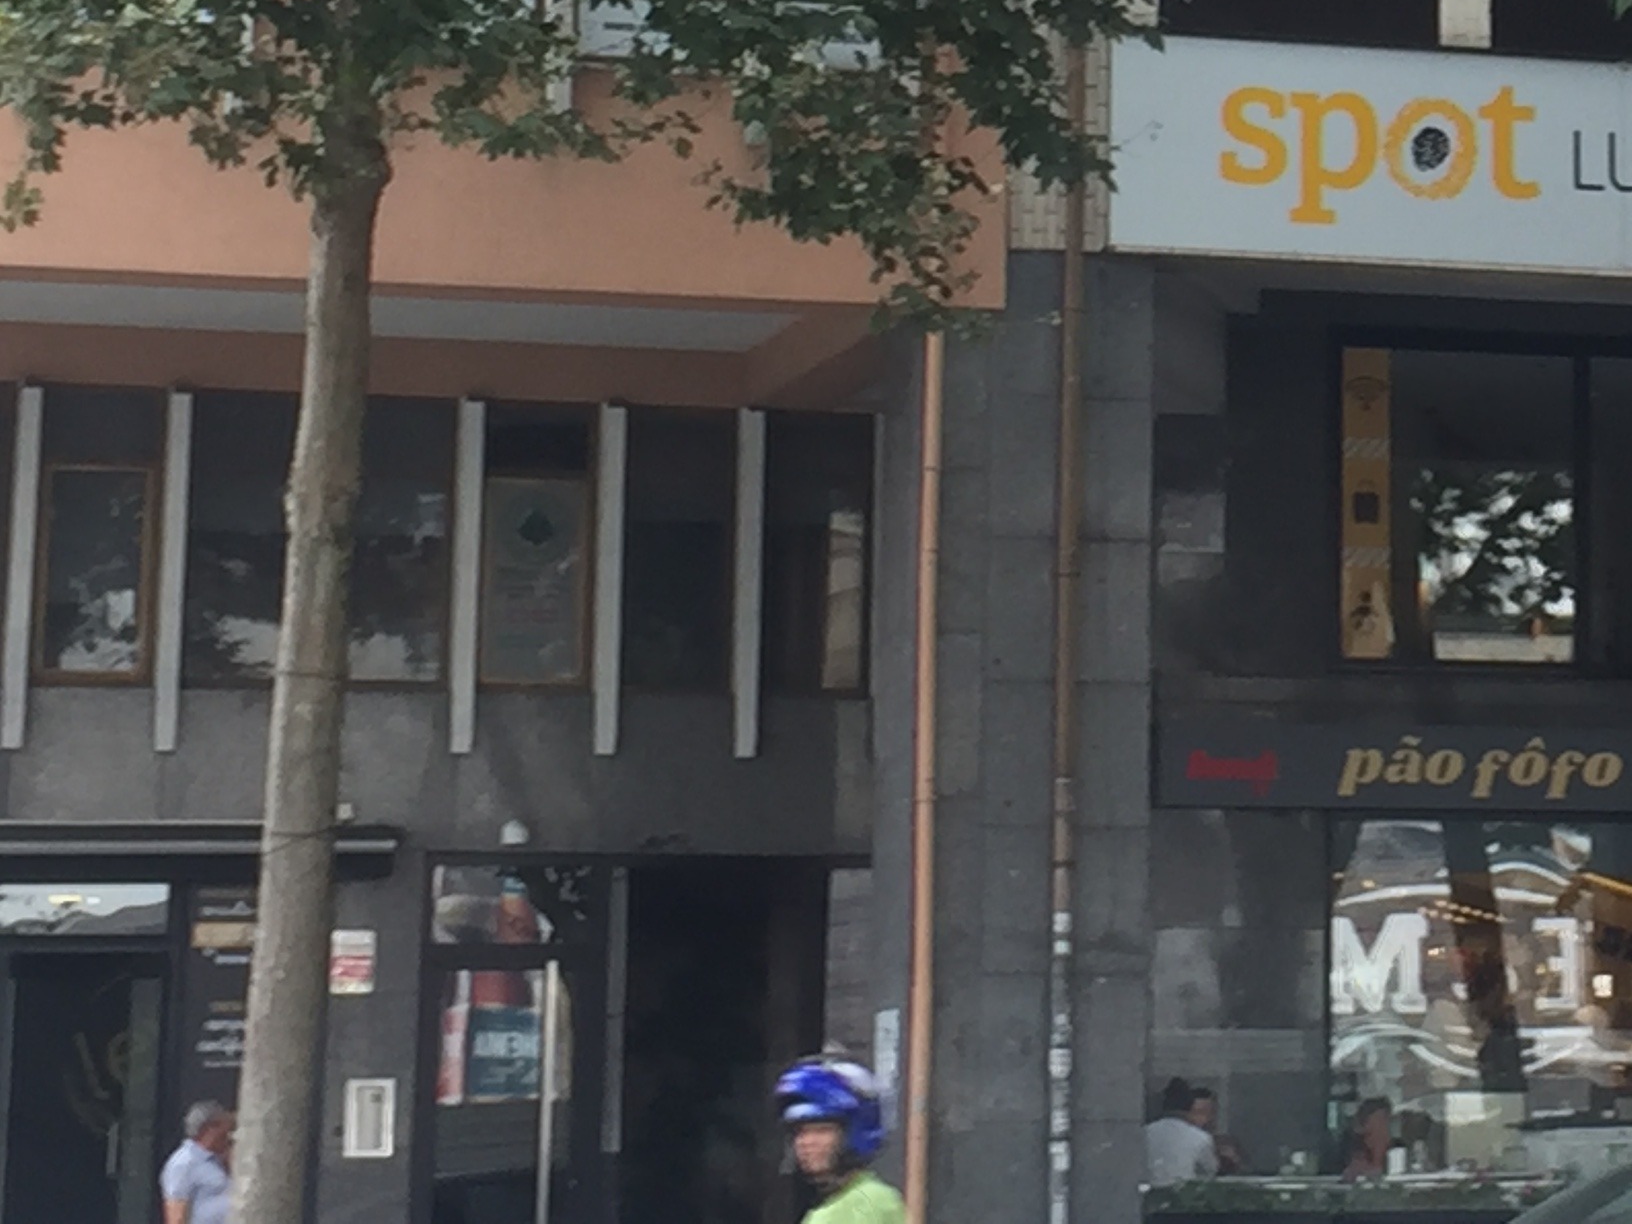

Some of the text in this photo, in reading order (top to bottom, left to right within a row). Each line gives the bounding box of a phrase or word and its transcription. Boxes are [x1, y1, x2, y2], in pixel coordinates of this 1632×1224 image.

[1218, 86, 1542, 225] spot
[1337, 735, 1465, 797] pão
[1471, 736, 1624, 799] fôfo
